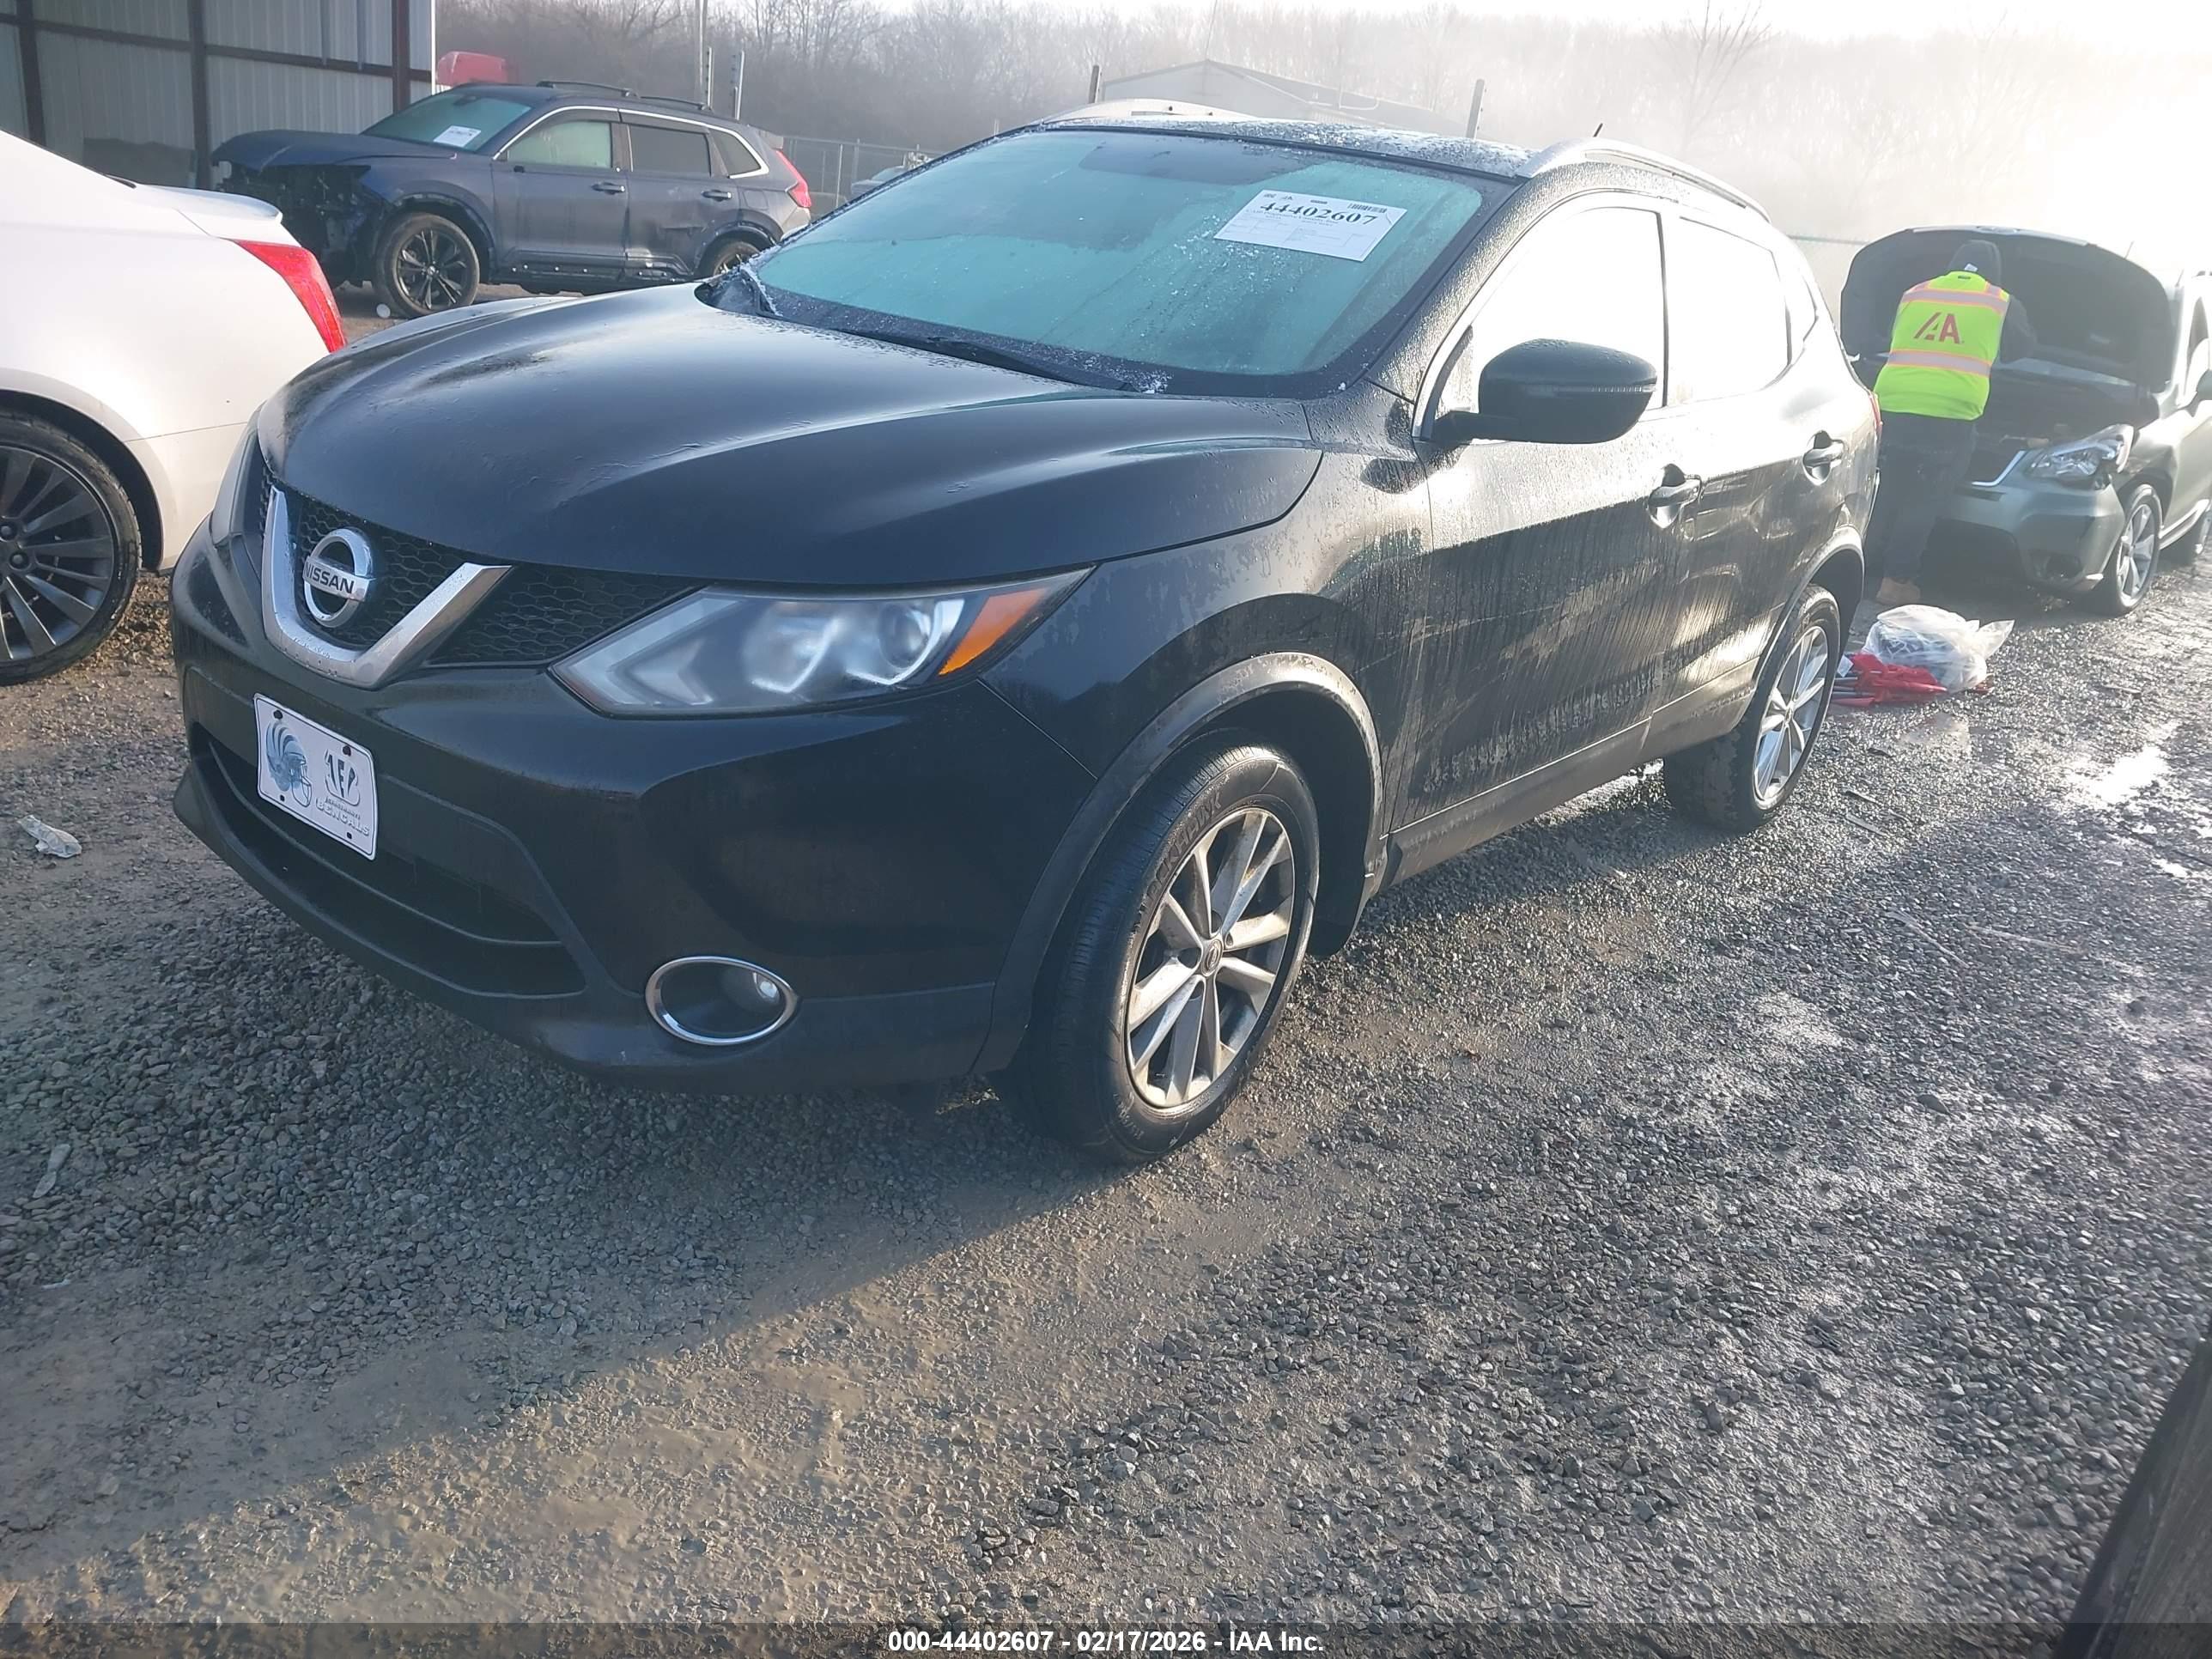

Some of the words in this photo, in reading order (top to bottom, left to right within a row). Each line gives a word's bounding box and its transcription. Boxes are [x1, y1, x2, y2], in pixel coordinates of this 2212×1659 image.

[1260, 201, 1377, 225] 44402607
[304, 560, 355, 594] NISSAN
[316, 797, 370, 836] BENGALS
